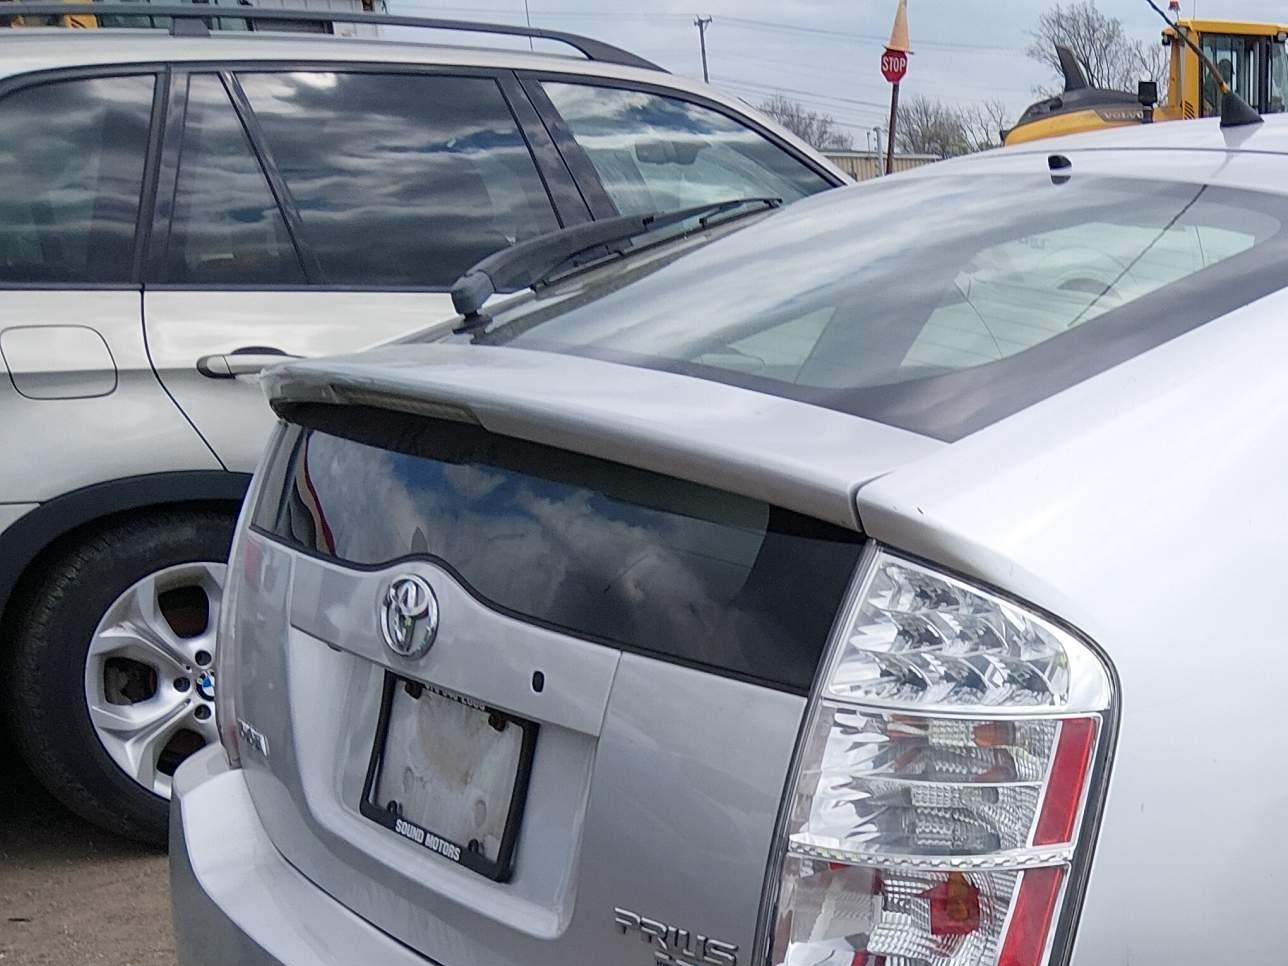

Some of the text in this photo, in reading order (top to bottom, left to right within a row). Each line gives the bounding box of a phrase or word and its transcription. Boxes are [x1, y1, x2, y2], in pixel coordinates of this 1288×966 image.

[882, 55, 906, 73] STOP
[1103, 110, 1144, 121] VOLVO
[395, 818, 461, 861] SOUND MOTORS
